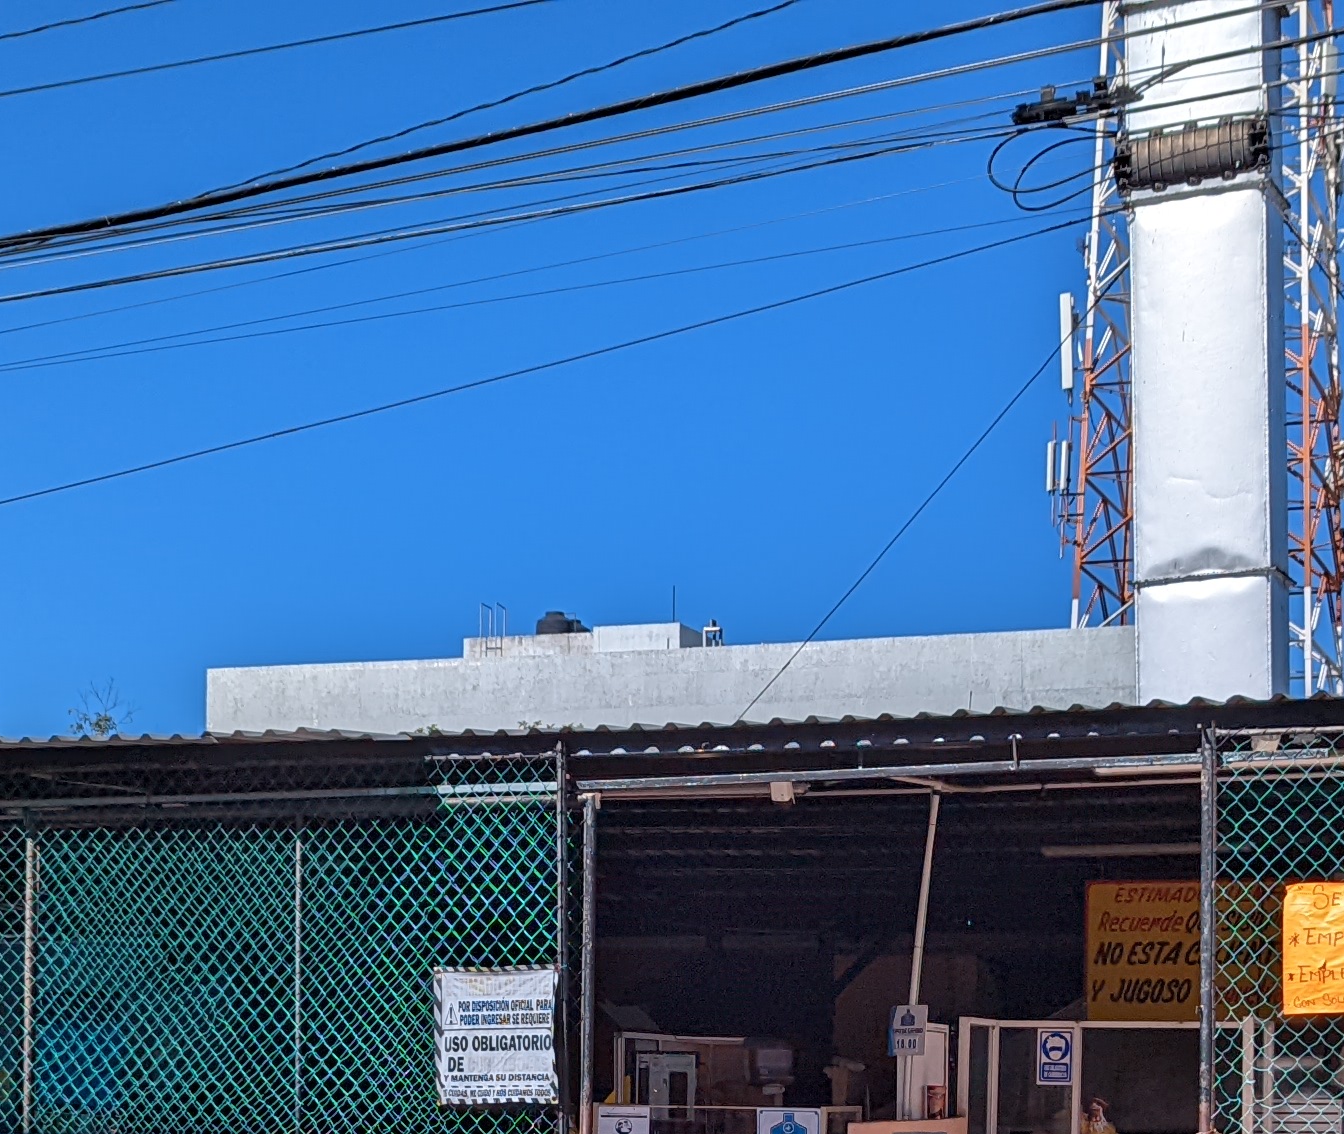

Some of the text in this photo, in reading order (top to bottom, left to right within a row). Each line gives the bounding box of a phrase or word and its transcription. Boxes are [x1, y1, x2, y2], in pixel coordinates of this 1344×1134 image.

[1098, 911, 1185, 933] Recuerde
[1094, 941, 1124, 965] NO
[1127, 941, 1183, 965] ESTA
[1092, 979, 1105, 1002] Y
[1110, 978, 1192, 1004] JUGOSO
[458, 1000, 470, 1012] POR
[510, 999, 534, 1011] OFICIAL
[536, 999, 553, 1010] PARA
[459, 1012, 550, 1027] PODER INGRESAR SE REQUIERE
[444, 1034, 552, 1052] USO OBLIGATORIO
[447, 1057, 465, 1072] DE
[444, 1073, 550, 1083] Y MANTENGA SU DISTANCIA
